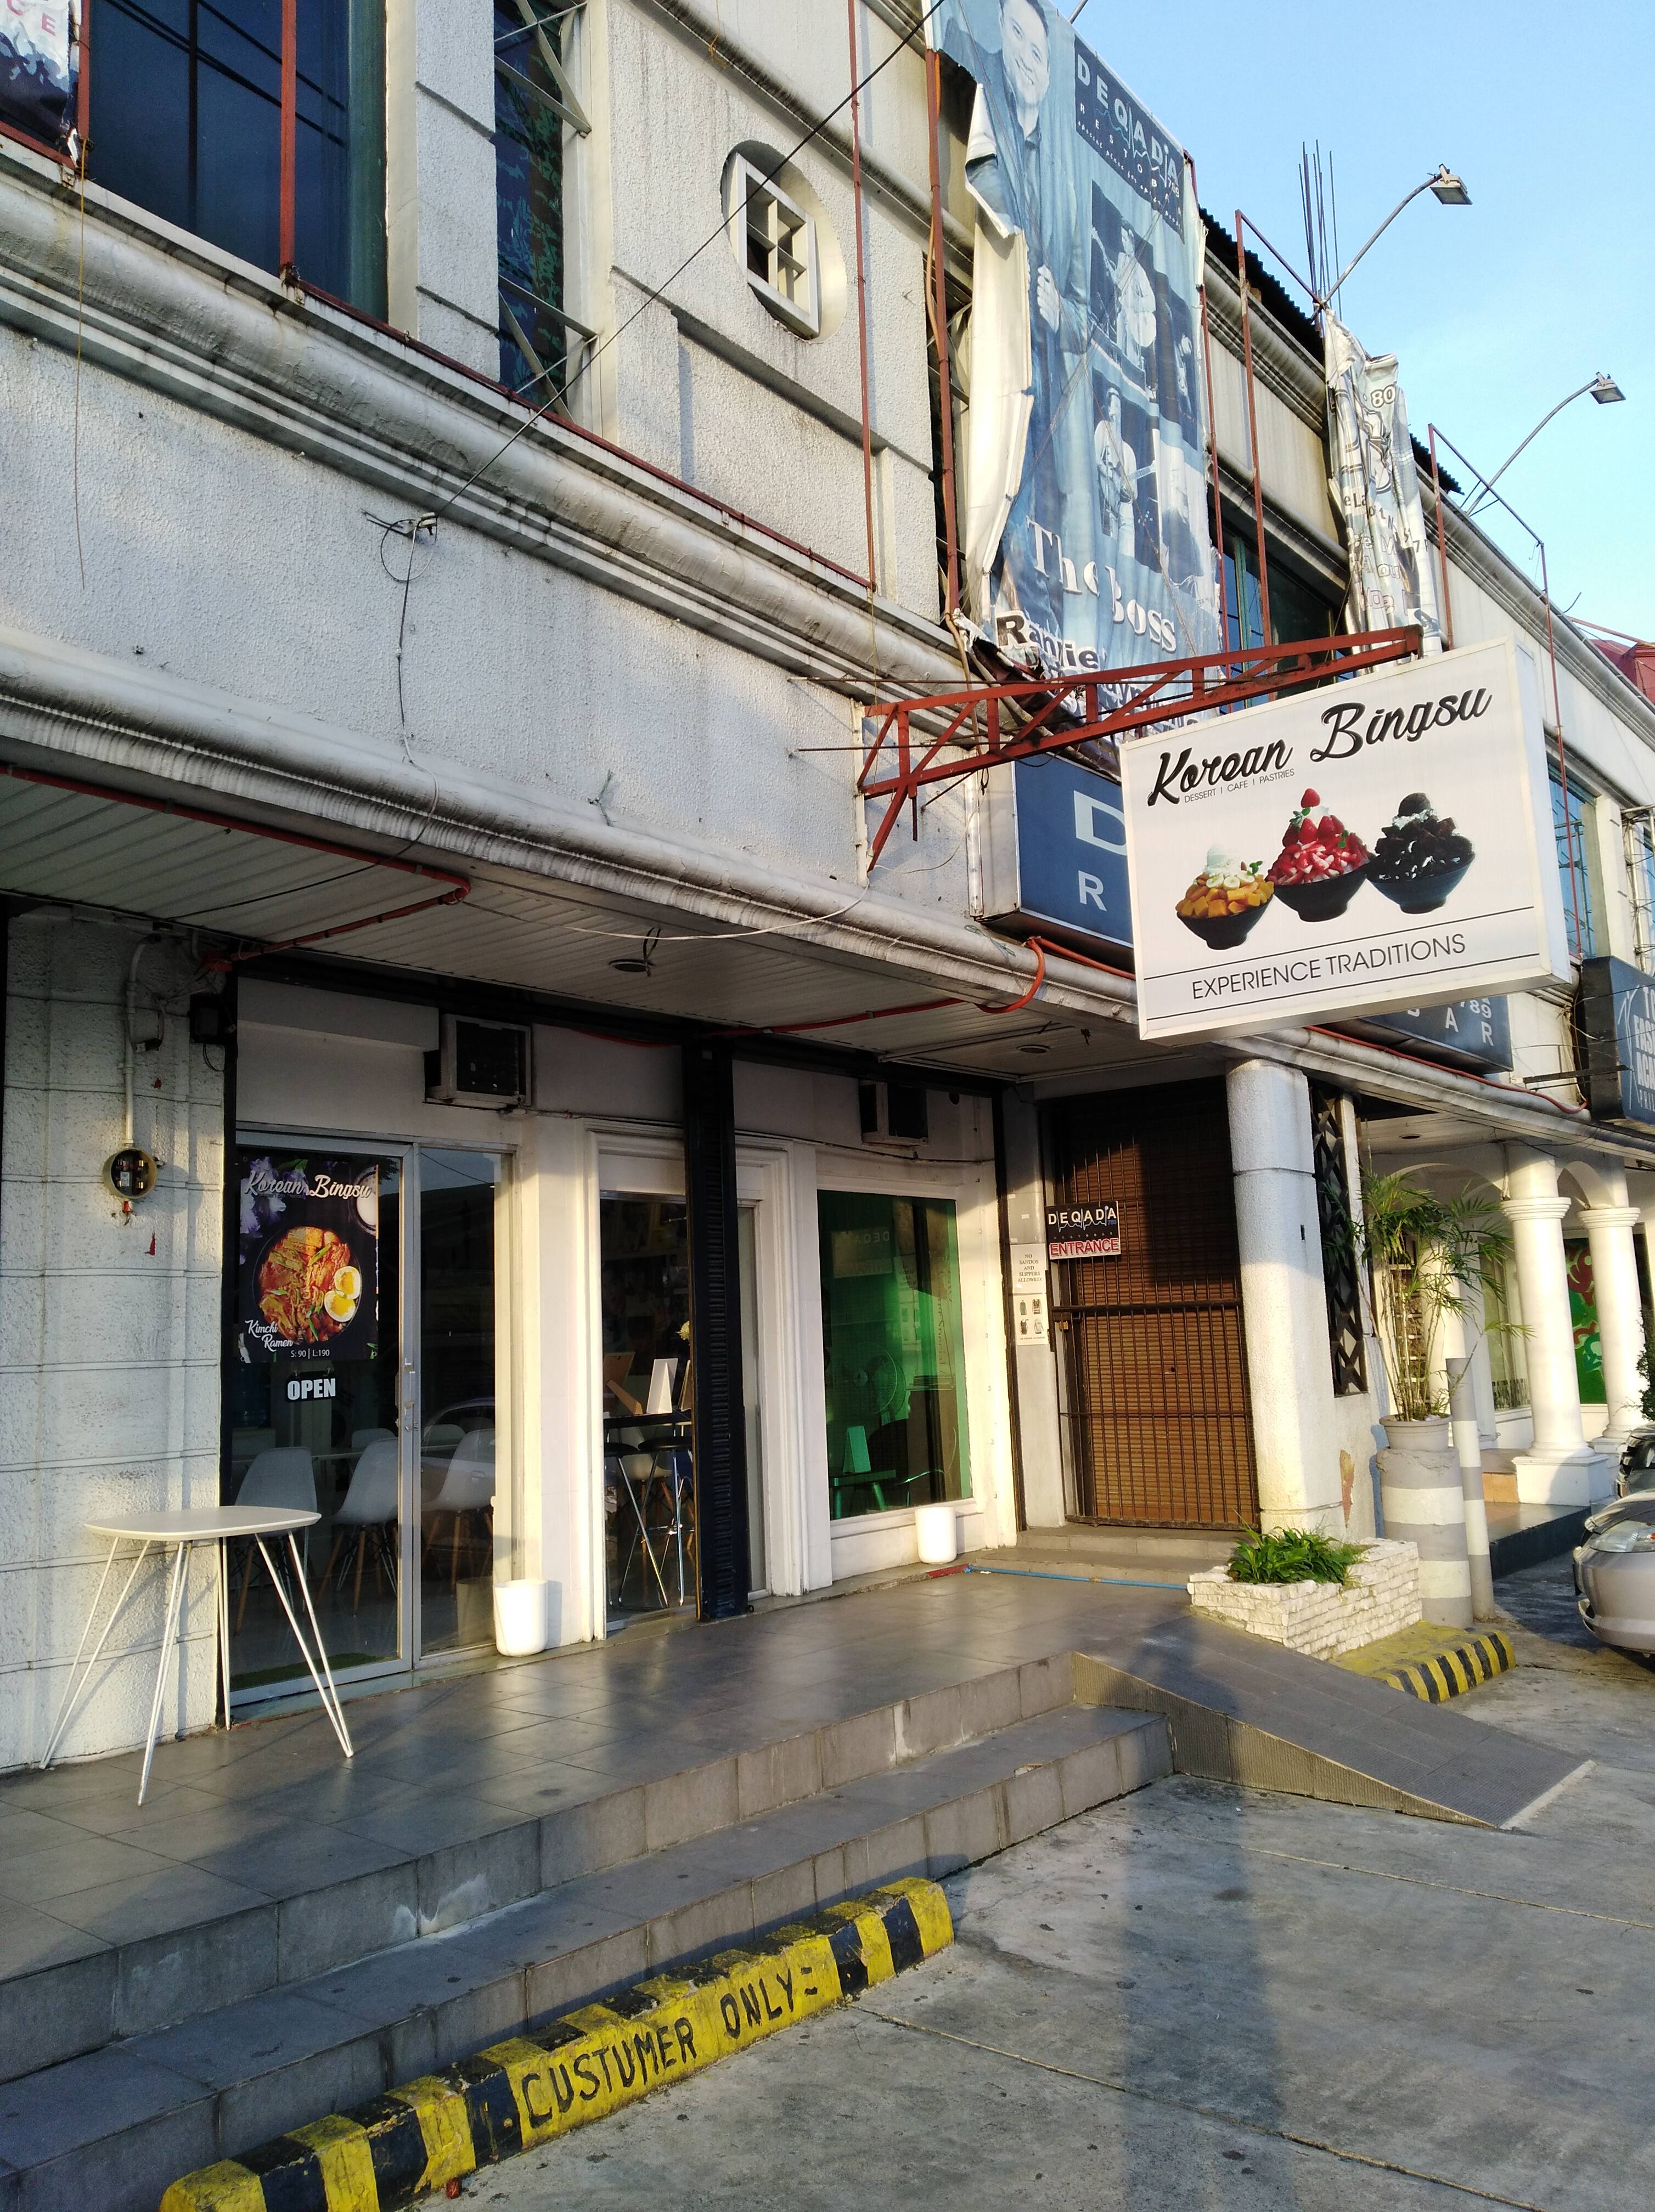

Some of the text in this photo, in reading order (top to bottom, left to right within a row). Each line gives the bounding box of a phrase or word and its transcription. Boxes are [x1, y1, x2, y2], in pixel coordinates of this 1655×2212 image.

[1147, 688, 1493, 806] Korean Bingsu
[1184, 768, 1295, 803] DESSERT CAFE PASTRIES
[1192, 933, 1466, 1000] EXPERIENCE TRADITIONS
[245, 1170, 373, 1200] Korean Bingsu
[1048, 1207, 1117, 1225] DEQADA
[1050, 1237, 1119, 1256] ENTRANCE
[245, 1319, 279, 1338] Kimchi
[261, 1334, 294, 1352] Ramen
[287, 1378, 336, 1400] OPEN
[520, 2016, 697, 2129] CUSTUMER
